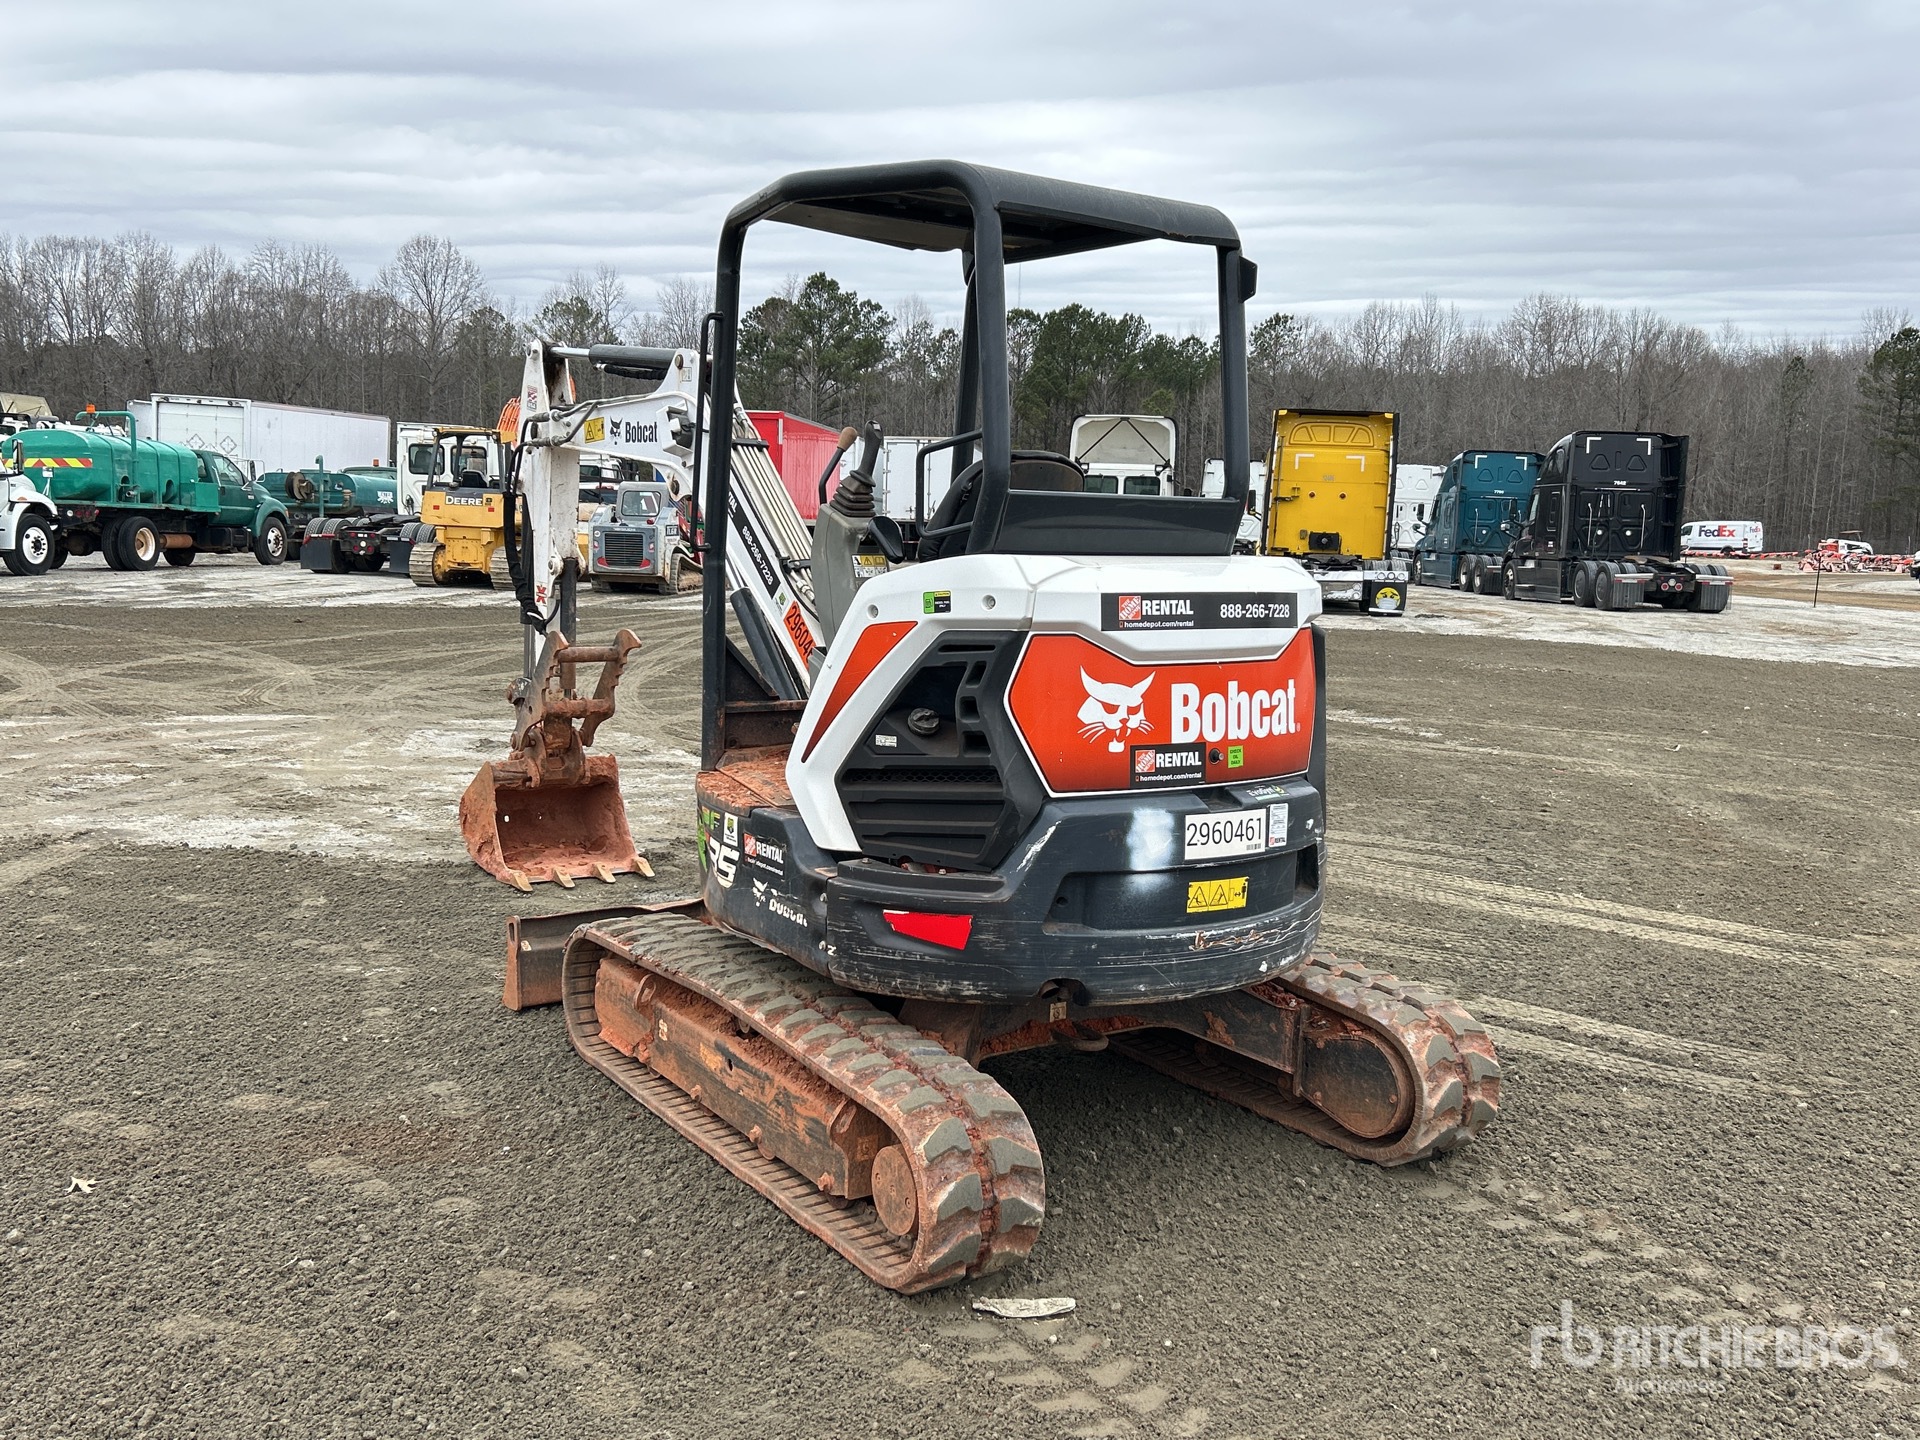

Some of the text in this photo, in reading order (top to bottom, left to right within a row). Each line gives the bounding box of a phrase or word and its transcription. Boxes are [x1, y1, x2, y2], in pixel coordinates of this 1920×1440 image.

[625, 421, 658, 443] Bobcat
[445, 496, 483, 506] DEERE
[1699, 525, 1736, 537] FedEx
[742, 525, 774, 585] 888-266-7228
[1119, 596, 1141, 620] HOME
[1142, 599, 1290, 618] RENTAL 888-266-7228
[1124, 620, 1194, 628] homedepot.com/rental
[1171, 679, 1296, 744] Bobcat
[1156, 751, 1202, 768] RENTAL
[1140, 772, 1202, 782] homedepot.com/rental
[1187, 818, 1262, 846] 2960461
[756, 841, 784, 864] RENTAL
